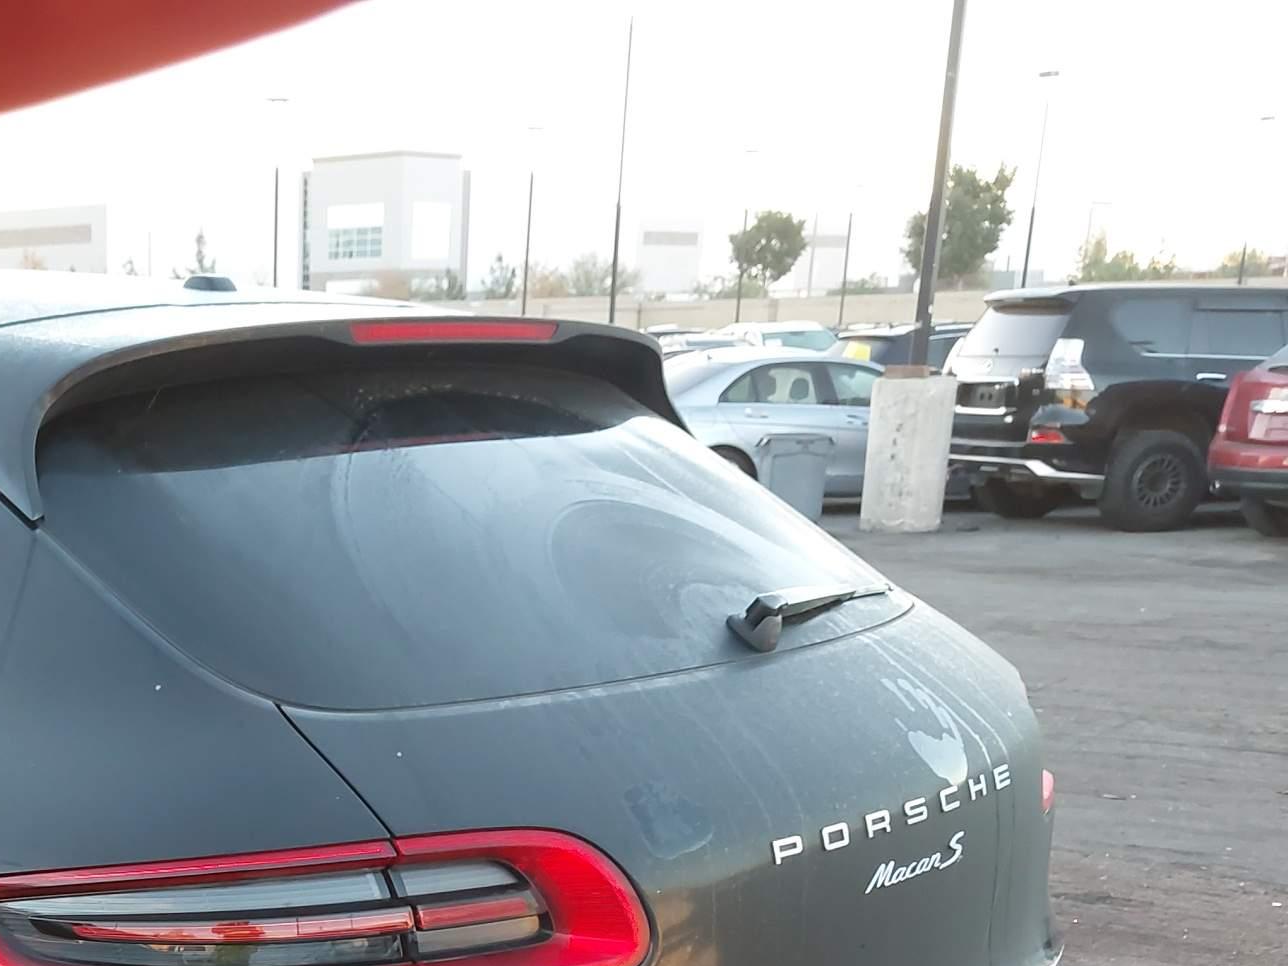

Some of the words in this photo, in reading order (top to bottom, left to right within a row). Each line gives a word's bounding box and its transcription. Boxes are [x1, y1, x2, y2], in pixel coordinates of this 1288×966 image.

[771, 763, 1012, 866] PORSCHE
[864, 851, 942, 894] Macan
[939, 830, 966, 871] S
